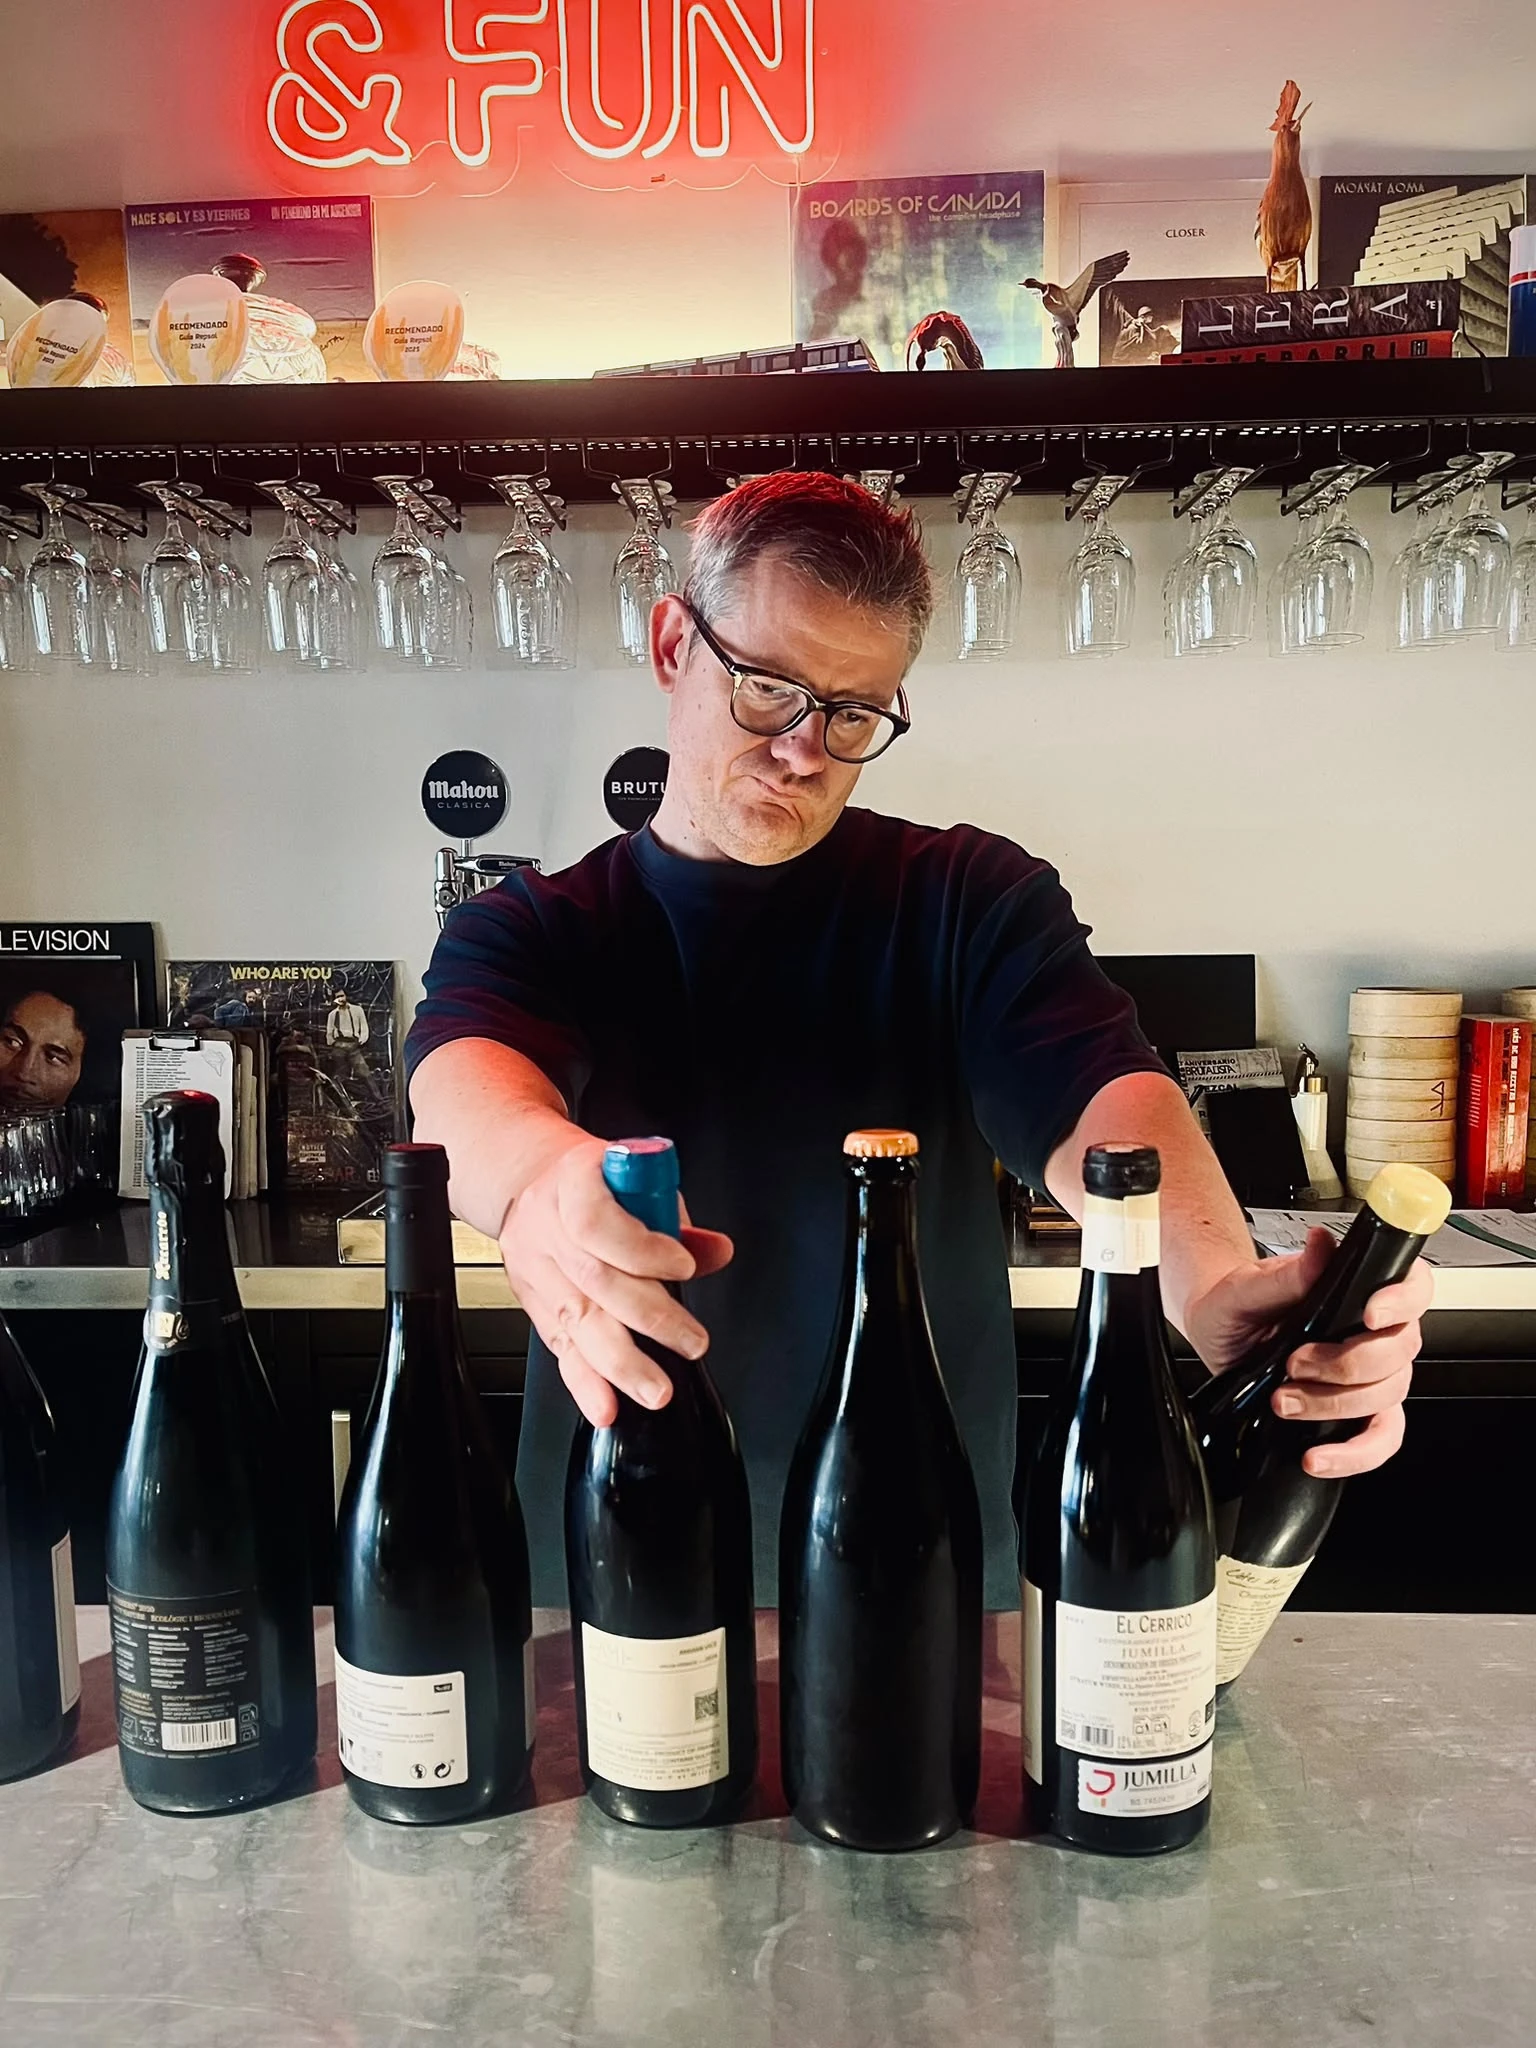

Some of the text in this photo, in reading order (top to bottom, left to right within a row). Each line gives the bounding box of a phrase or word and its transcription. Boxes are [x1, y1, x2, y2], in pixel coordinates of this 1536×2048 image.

[267, 0, 815, 169] & FUN
[810, 191, 1021, 219] BOARDS OF CANADA
[131, 213, 157, 226] HACE
[183, 210, 191, 223] Y
[193, 210, 205, 222] ES
[207, 208, 250, 222] VIERNES
[929, 210, 1021, 222] the campfire headphase
[1165, 227, 1206, 239] CLOSER
[169, 321, 228, 331] RECOMENDADO
[385, 325, 443, 335] RECOMENDADO
[195, 332, 218, 341] Repsol
[410, 336, 433, 344] Repsol
[35, 336, 79, 354] RECOMENDADO
[428, 780, 499, 799] Mahou
[0, 930, 110, 951] LEVISION
[231, 967, 332, 980] WHO ARE YOU
[1184, 1058, 1236, 1067] ANIVERSARIO
[1185, 1065, 1237, 1076] BRUTALISTA
[1116, 1613, 1192, 1634] EL CERRICO
[1121, 1644, 1186, 1659] JUMILLA
[1123, 1762, 1197, 1791] JUMILLA
